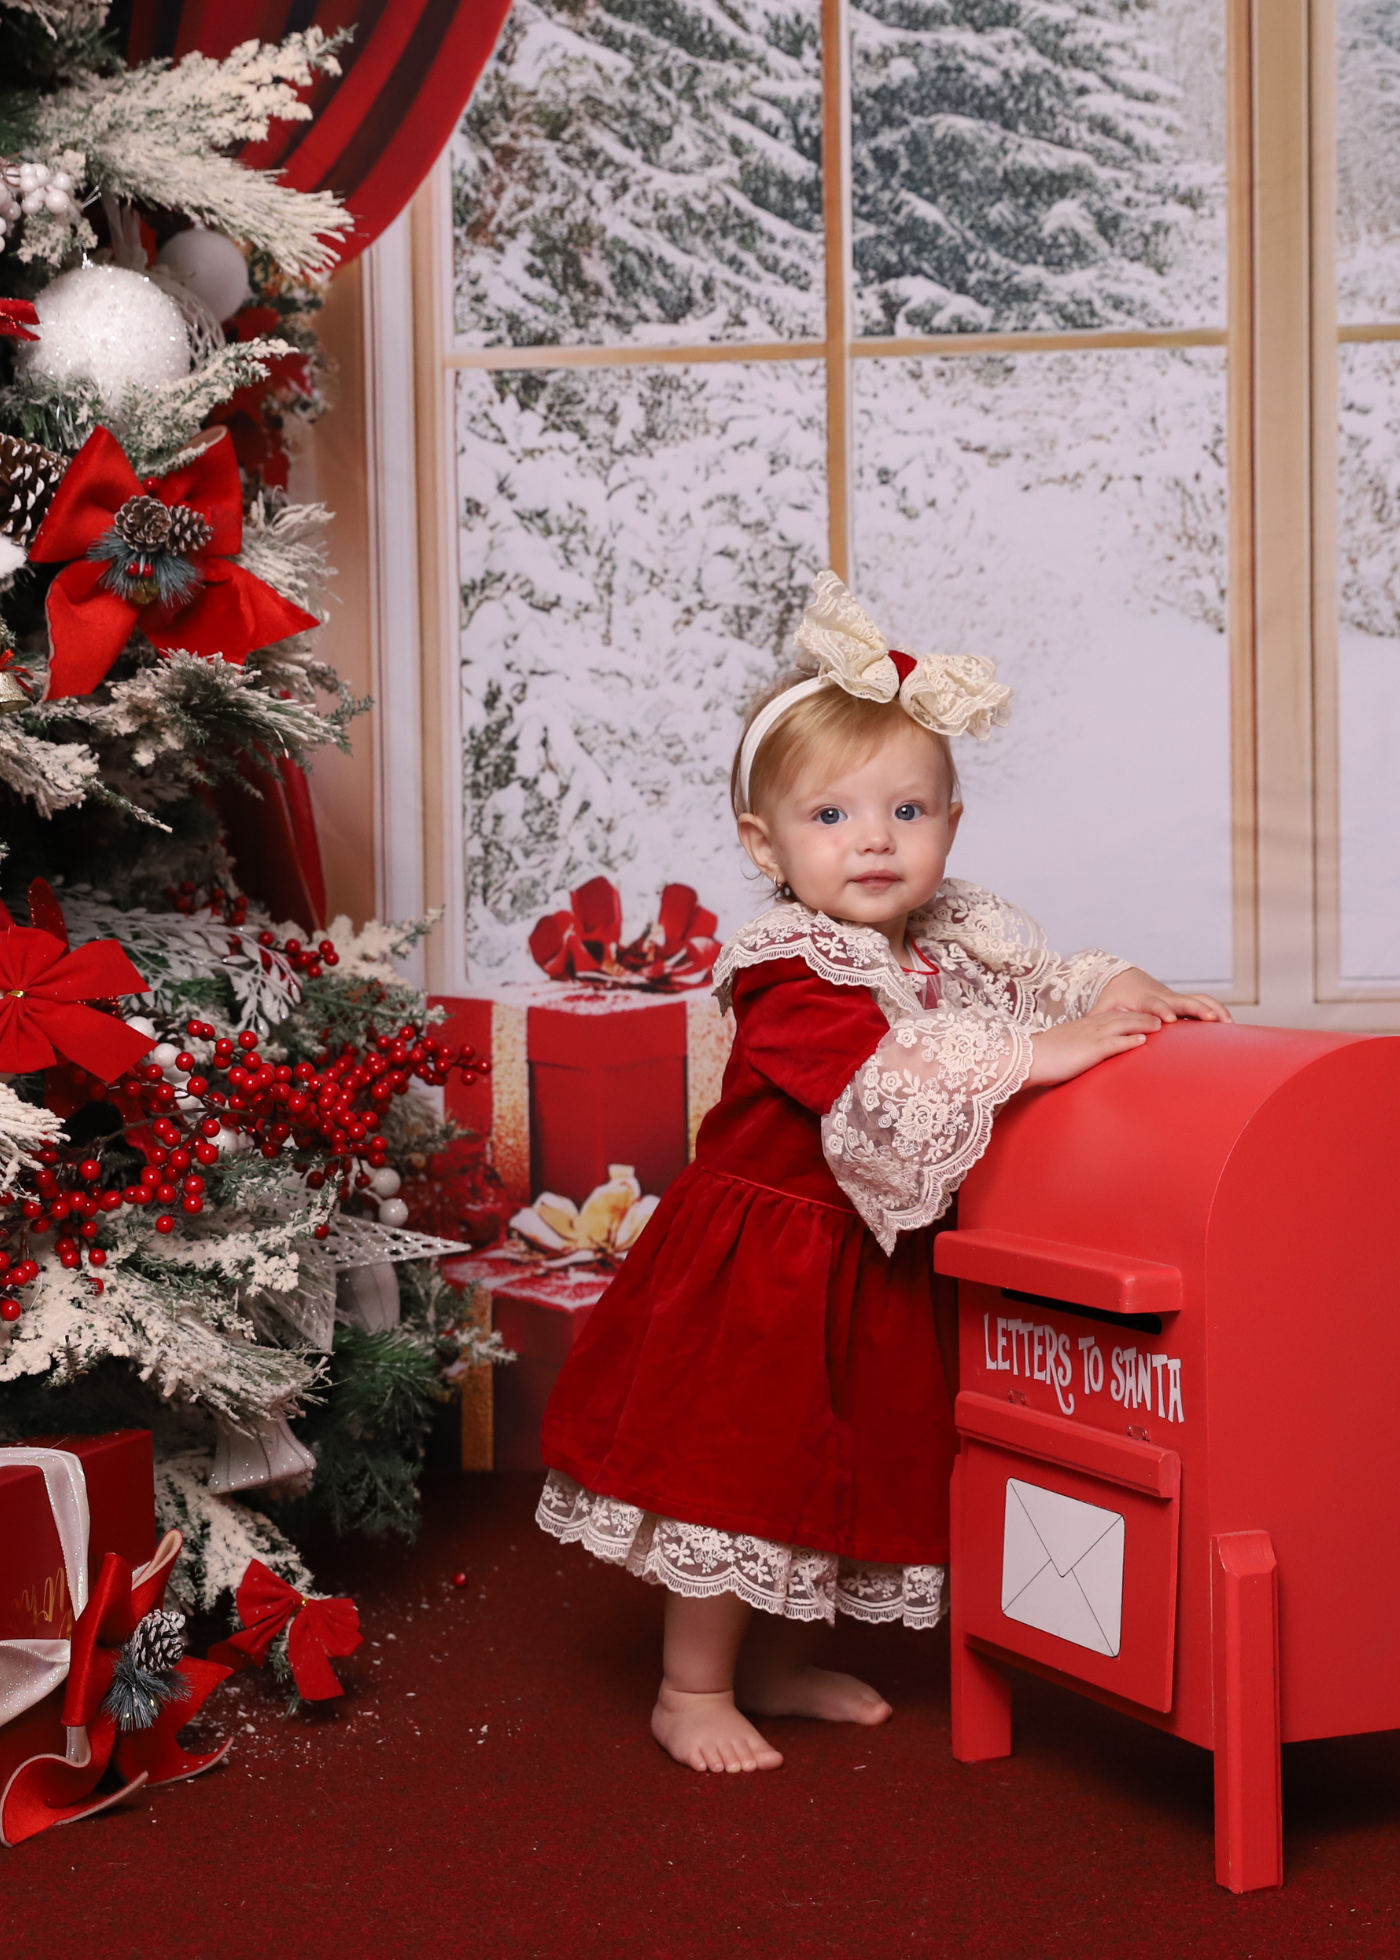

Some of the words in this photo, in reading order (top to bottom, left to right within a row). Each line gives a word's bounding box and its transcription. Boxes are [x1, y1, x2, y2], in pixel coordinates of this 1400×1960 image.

[984, 1313, 1075, 1415] LETTERS
[1078, 1336, 1104, 1395] TO
[1110, 1347, 1185, 1423] SANTA
